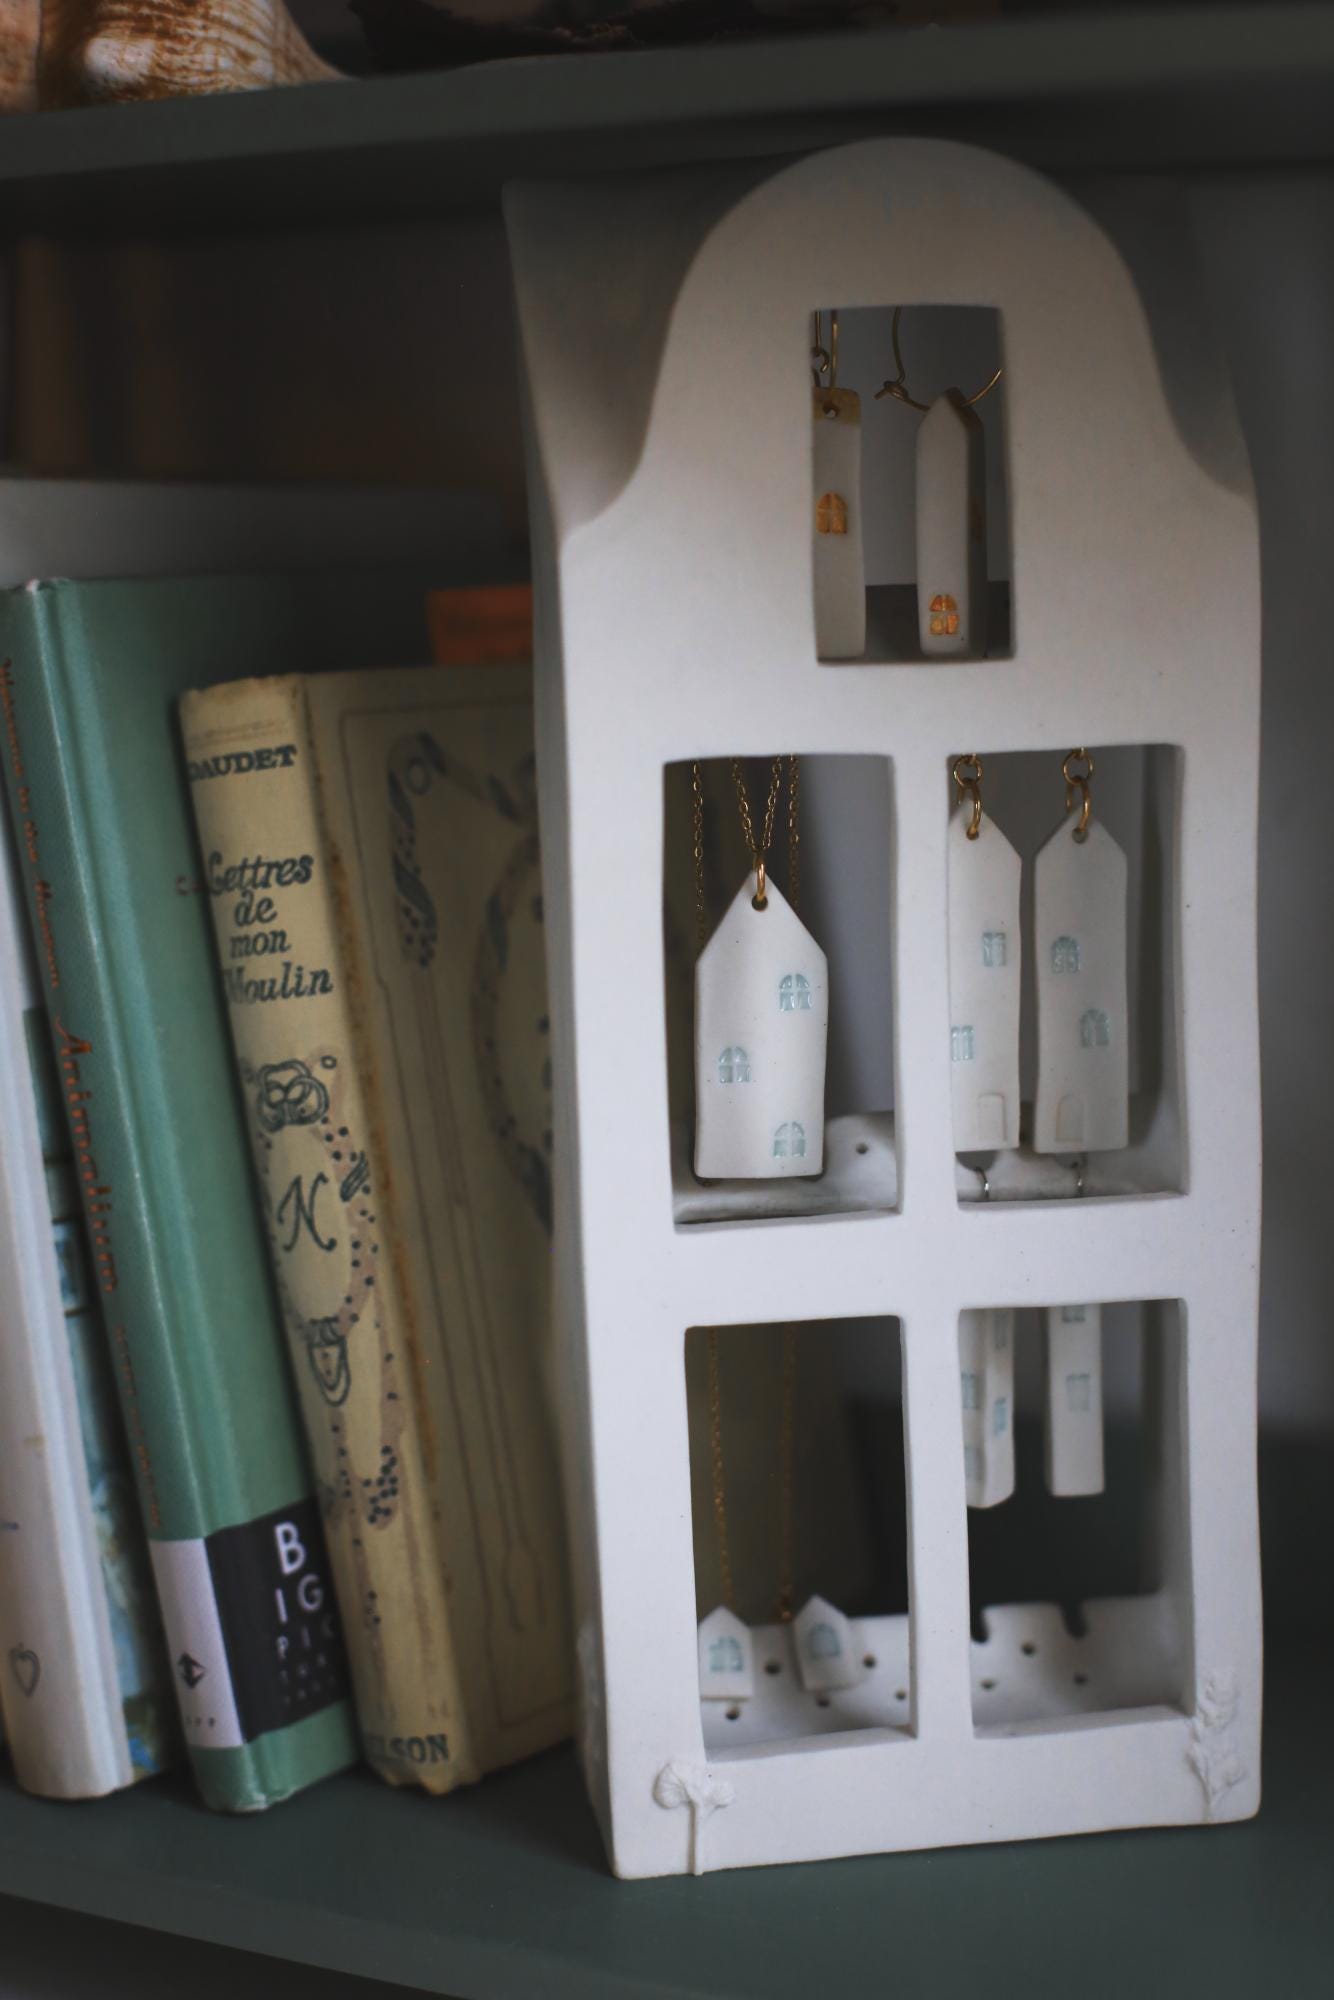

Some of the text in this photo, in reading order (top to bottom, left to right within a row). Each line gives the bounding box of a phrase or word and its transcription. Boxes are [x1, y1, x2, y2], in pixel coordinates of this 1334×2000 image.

[186, 744, 297, 782] DAUDET
[208, 850, 314, 894] Lettres
[234, 888, 277, 926] de
[229, 927, 289, 959] mon
